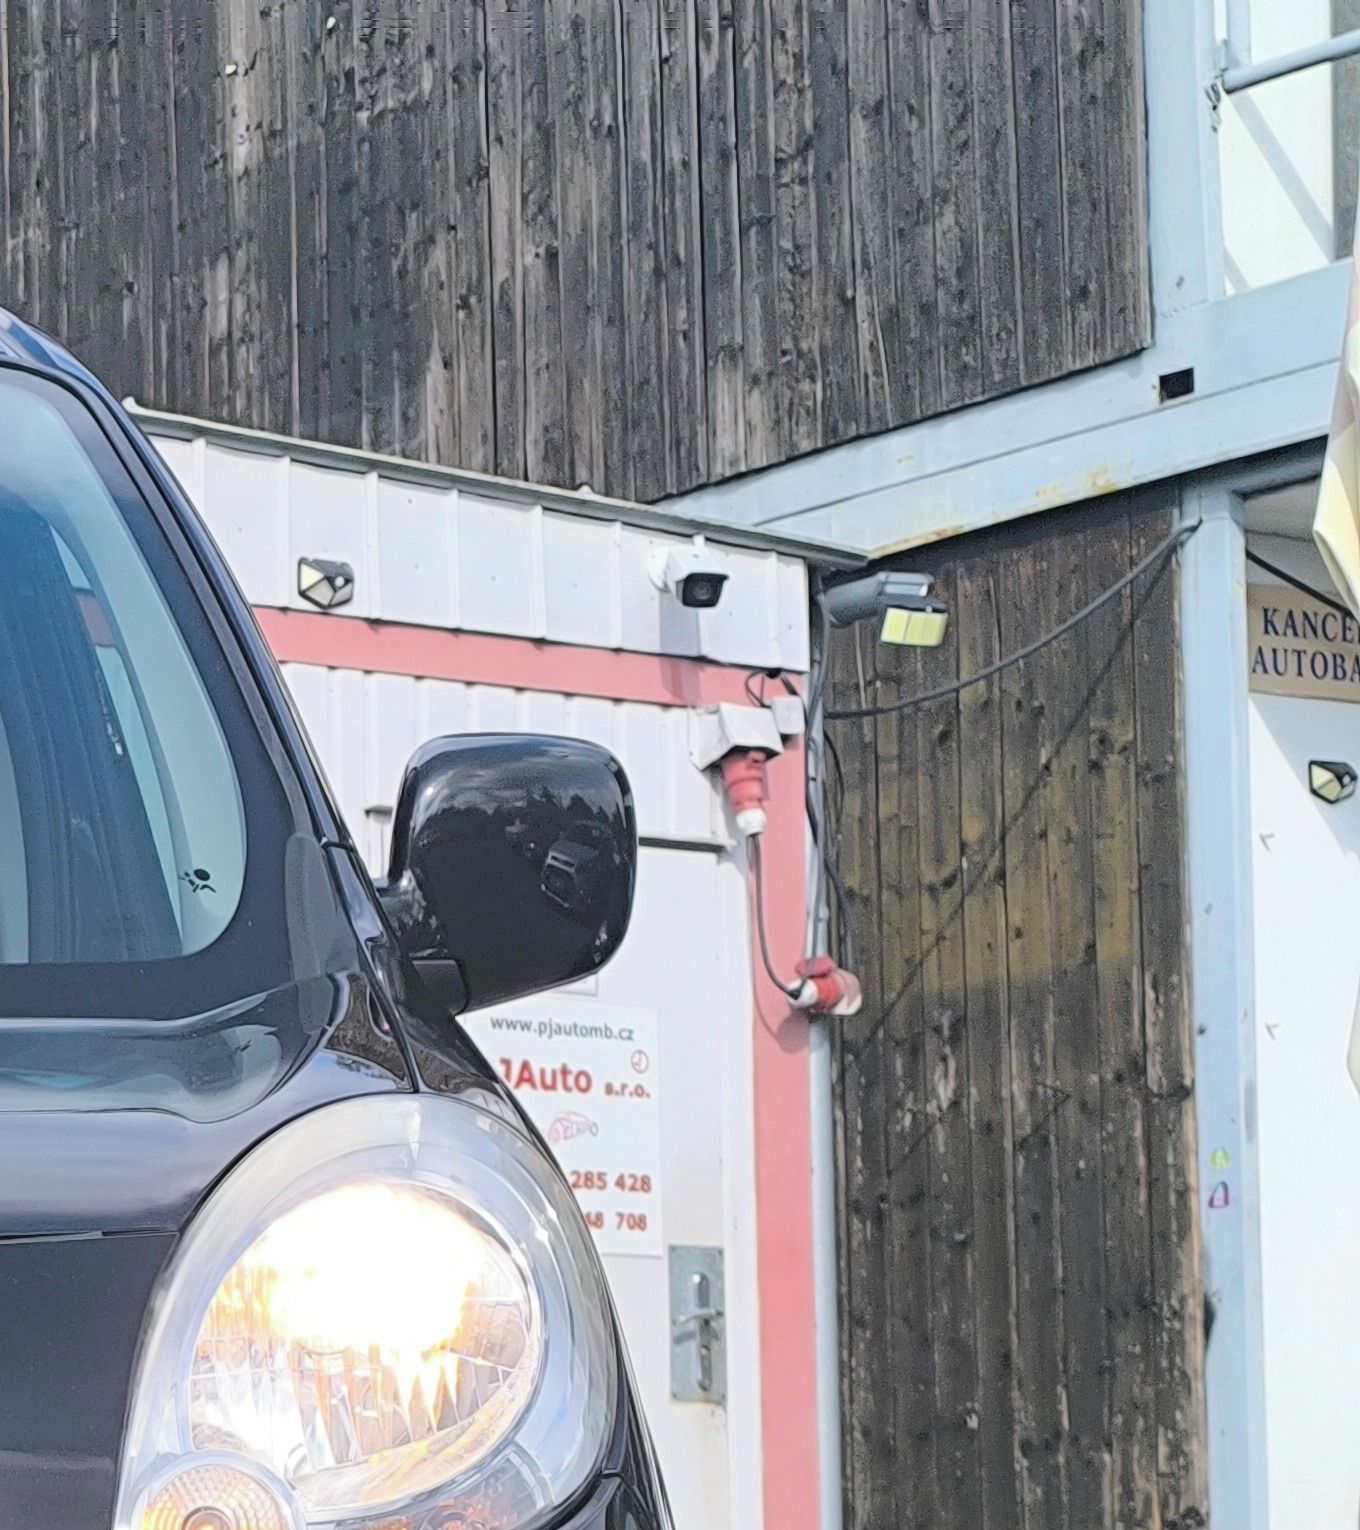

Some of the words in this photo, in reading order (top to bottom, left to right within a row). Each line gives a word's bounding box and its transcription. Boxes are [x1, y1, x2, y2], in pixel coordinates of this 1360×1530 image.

[1262, 606, 1360, 644] KANCE
[489, 1016, 635, 1042] www.pjautomb.cz
[604, 1081, 651, 1099] s.r.o.
[569, 1169, 608, 1192] 285
[614, 1172, 652, 1194] 428
[615, 1211, 648, 1232] 708
